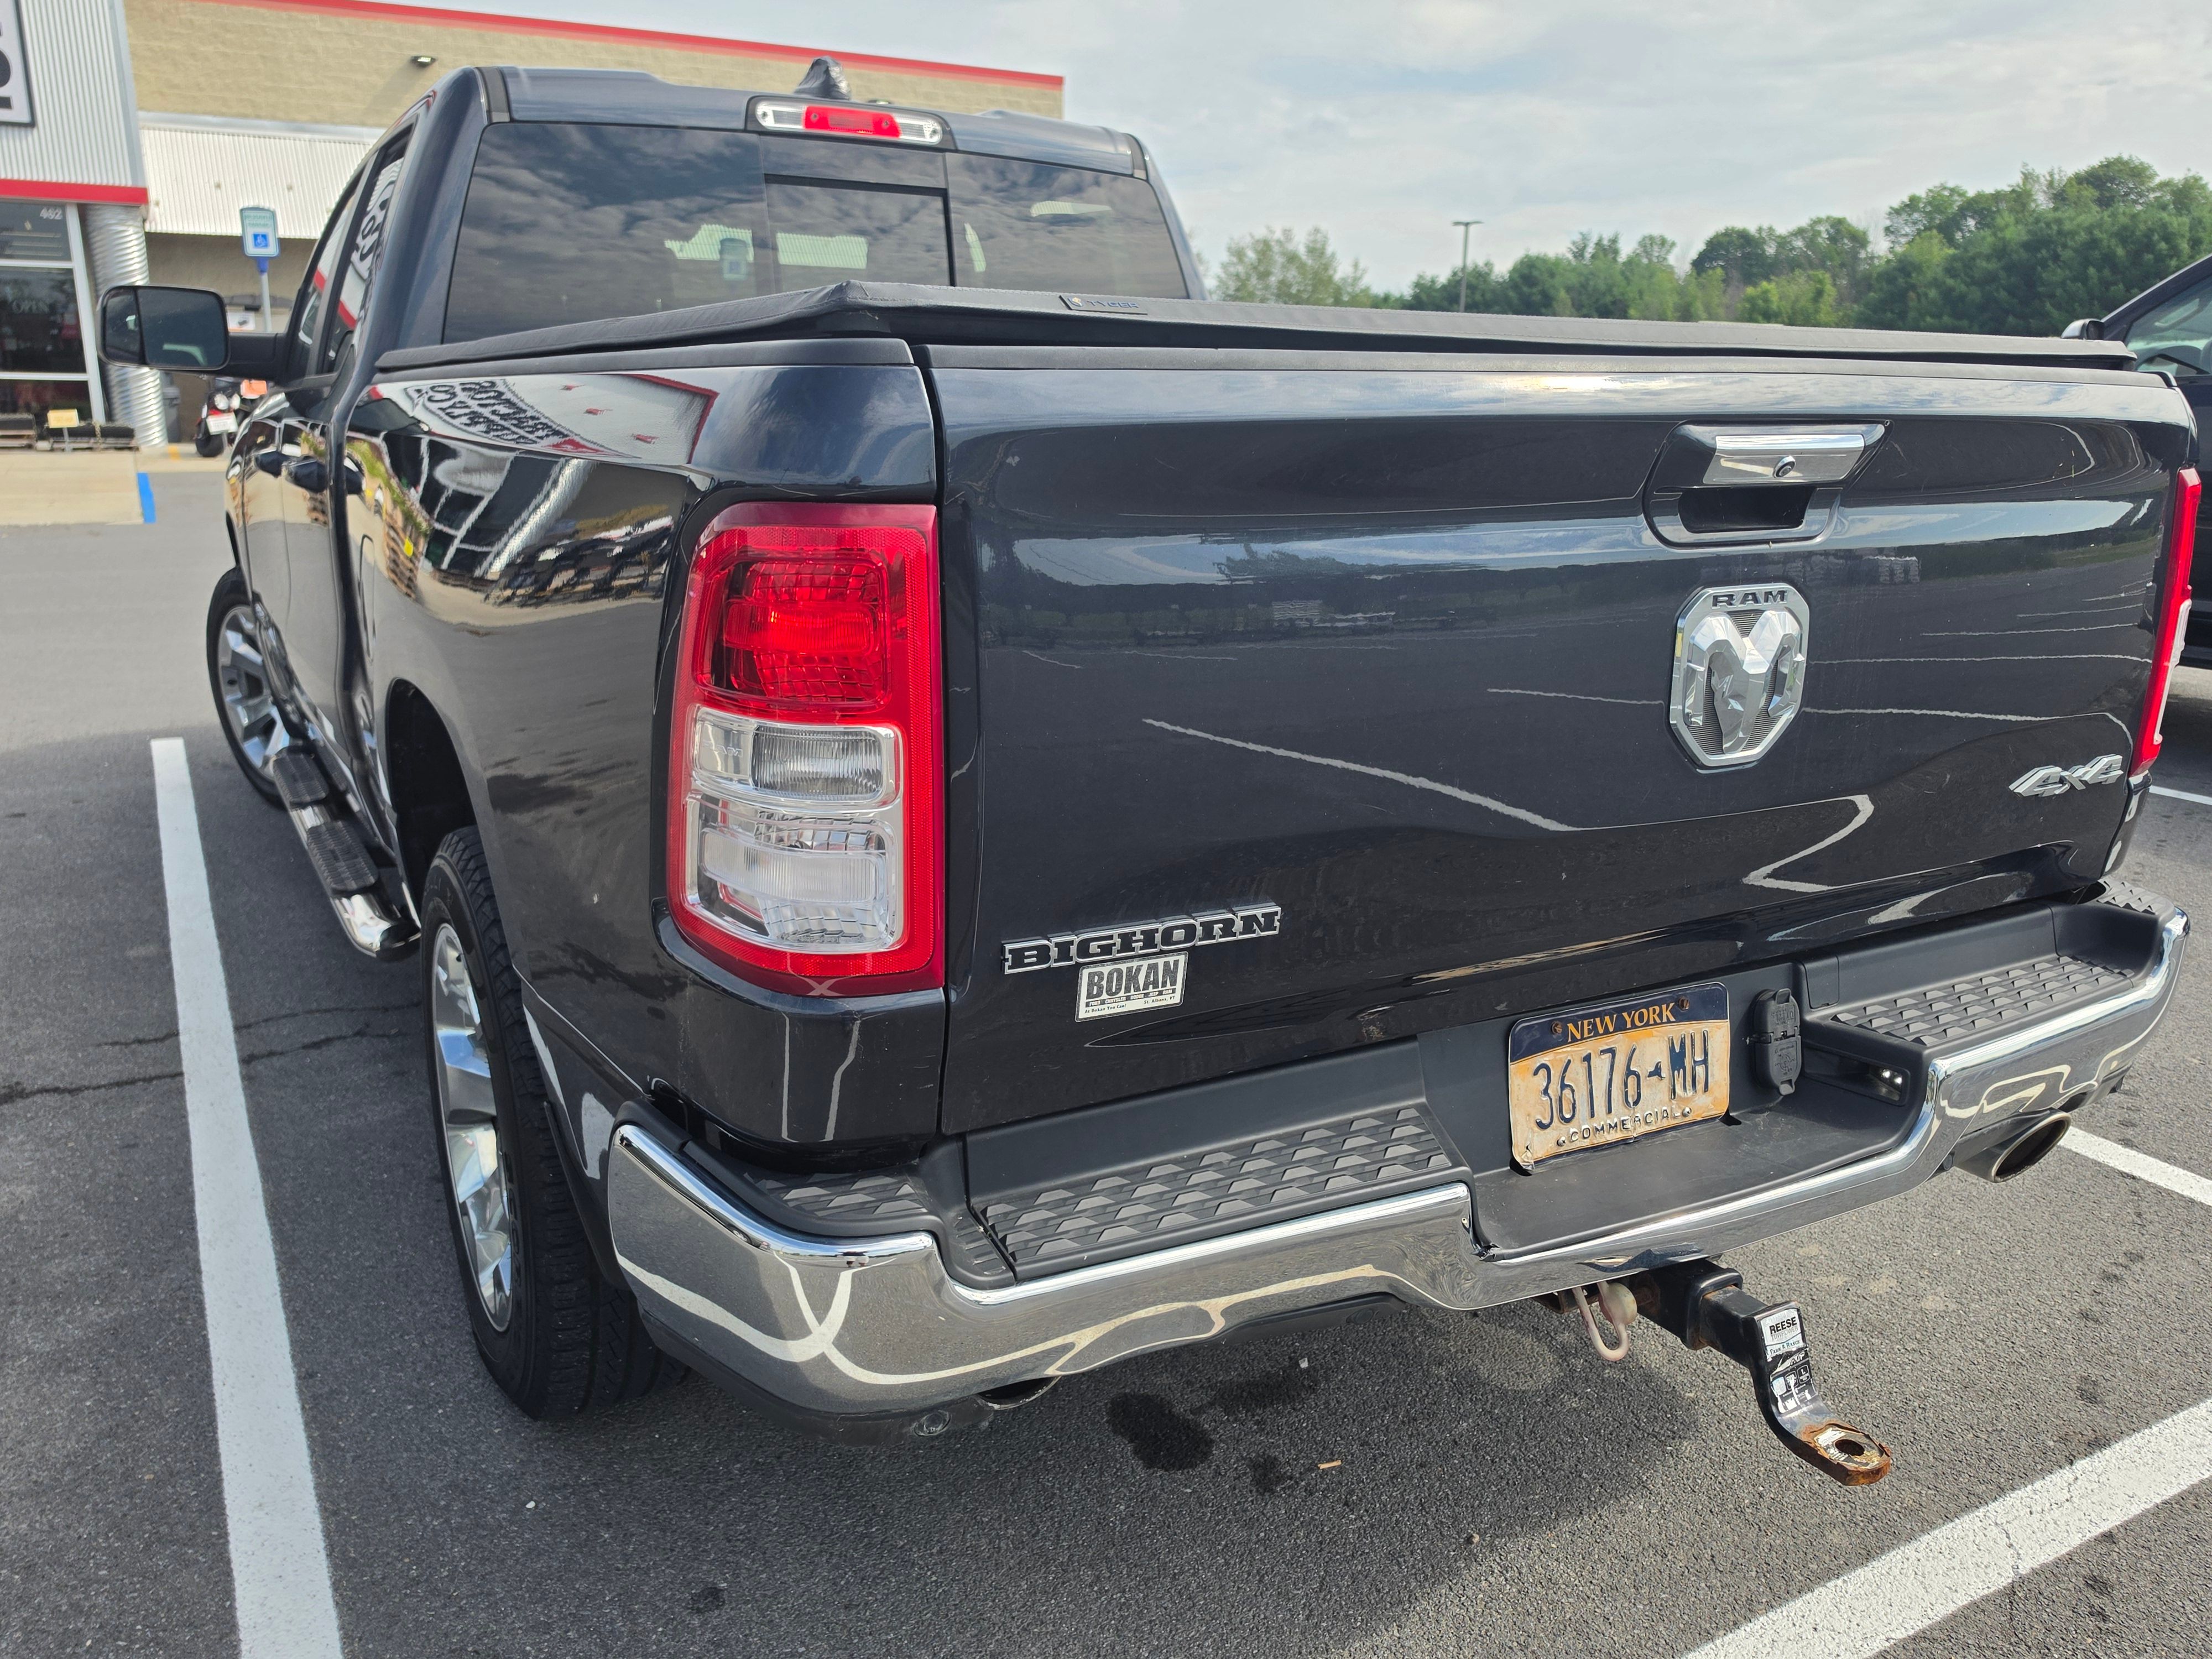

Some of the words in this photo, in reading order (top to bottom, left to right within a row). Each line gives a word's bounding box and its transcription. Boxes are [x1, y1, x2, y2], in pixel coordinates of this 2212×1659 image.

[1087, 300, 1139, 309] TYGER
[1712, 589, 1787, 609] RAM
[1003, 905, 1281, 974] BIGHORN
[1086, 959, 1180, 1000] BOKAN
[1567, 1014, 1617, 1042] NEW
[1622, 1002, 1676, 1029] YORK
[1569, 1106, 1681, 1142] COMMERCIAL
[1769, 1317, 1797, 1334] REESE
[1771, 1326, 1798, 1342] TOWPOWER
